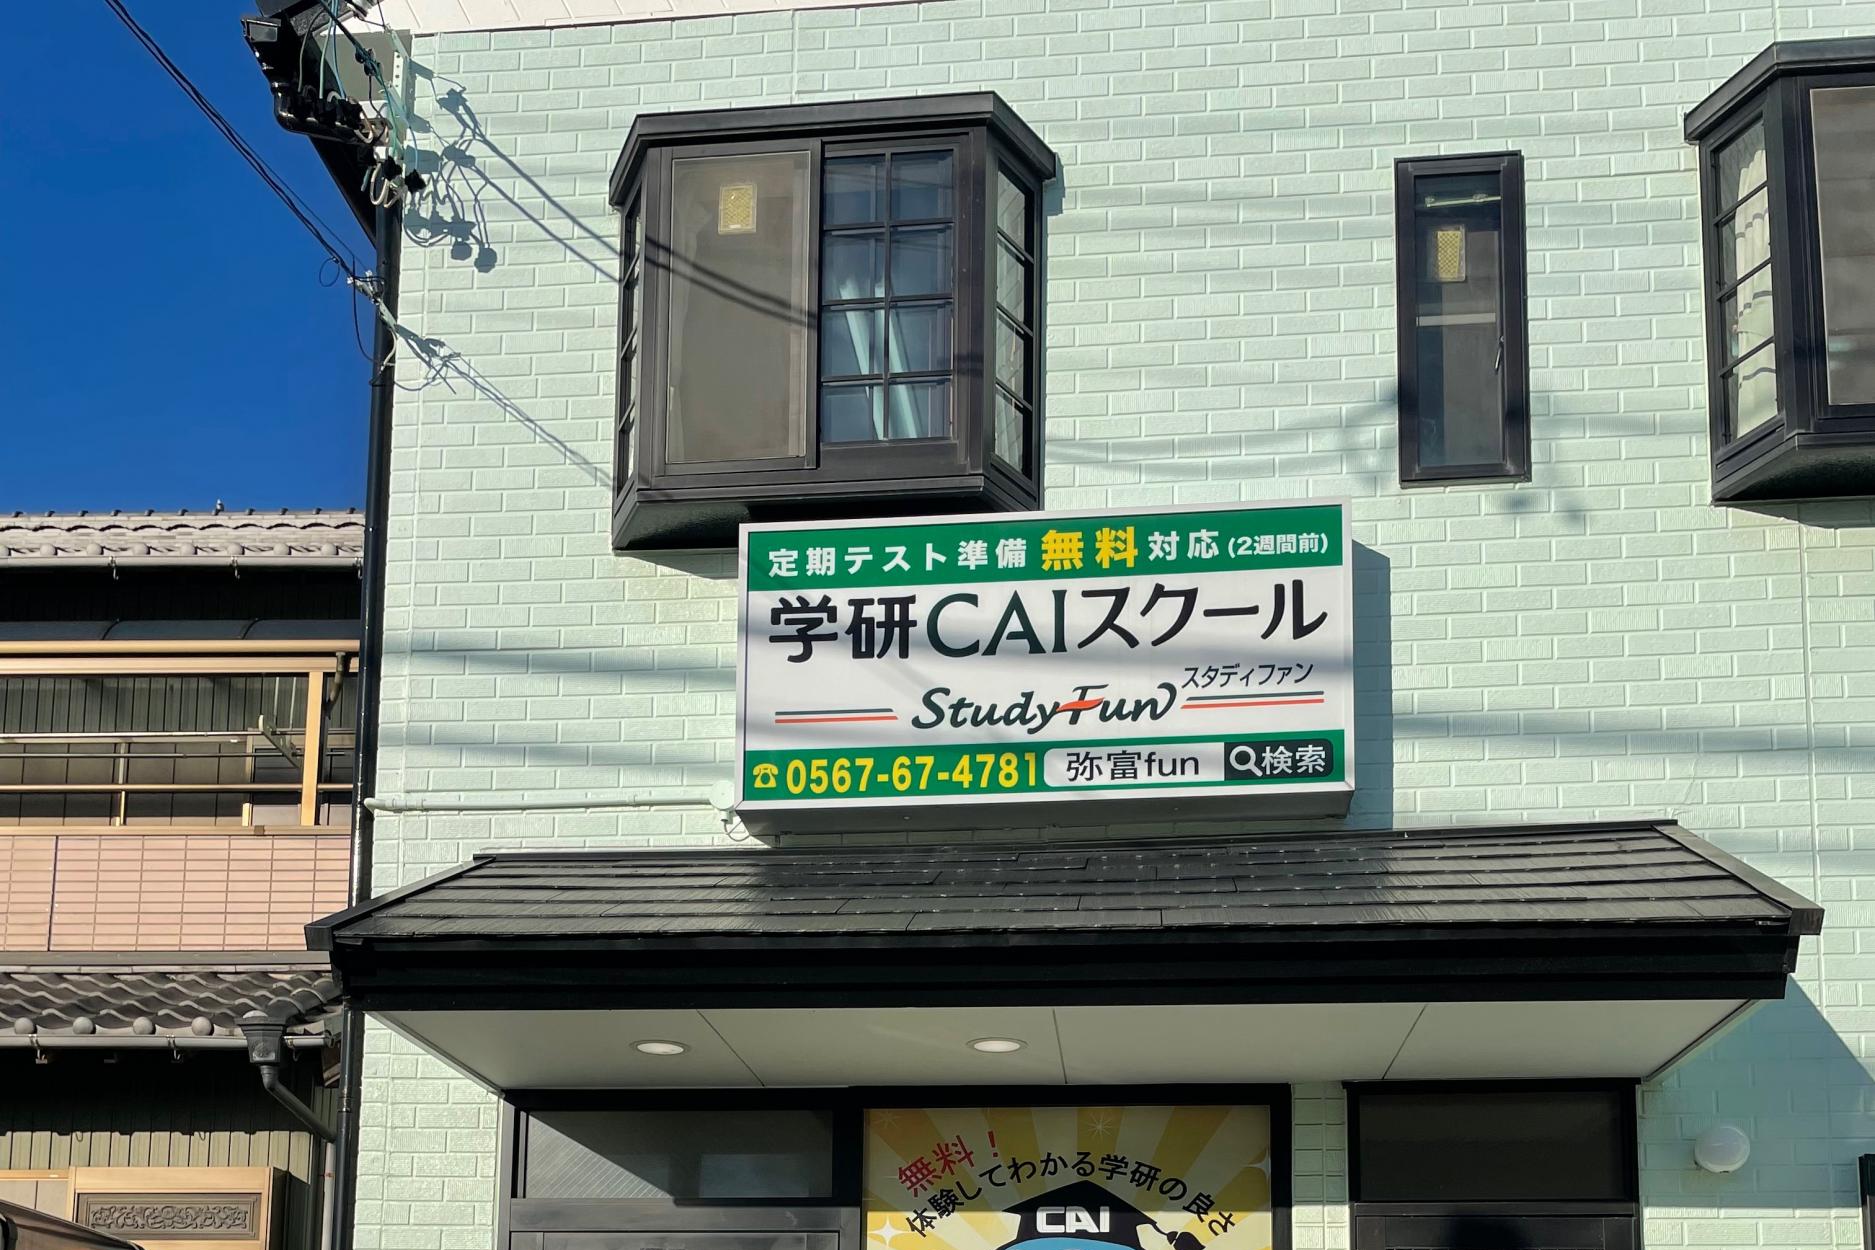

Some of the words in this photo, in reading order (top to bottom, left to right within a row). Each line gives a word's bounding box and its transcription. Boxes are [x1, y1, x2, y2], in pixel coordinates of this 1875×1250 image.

[768, 578, 1329, 664] 学研CAIスクール
[1182, 663, 1315, 690] スタディファン
[785, 751, 1038, 796] 0567-67-4781
[1065, 750, 1201, 782] 弥富fun
[1260, 744, 1327, 776] 検索
[1036, 1205, 1111, 1234] CAI
